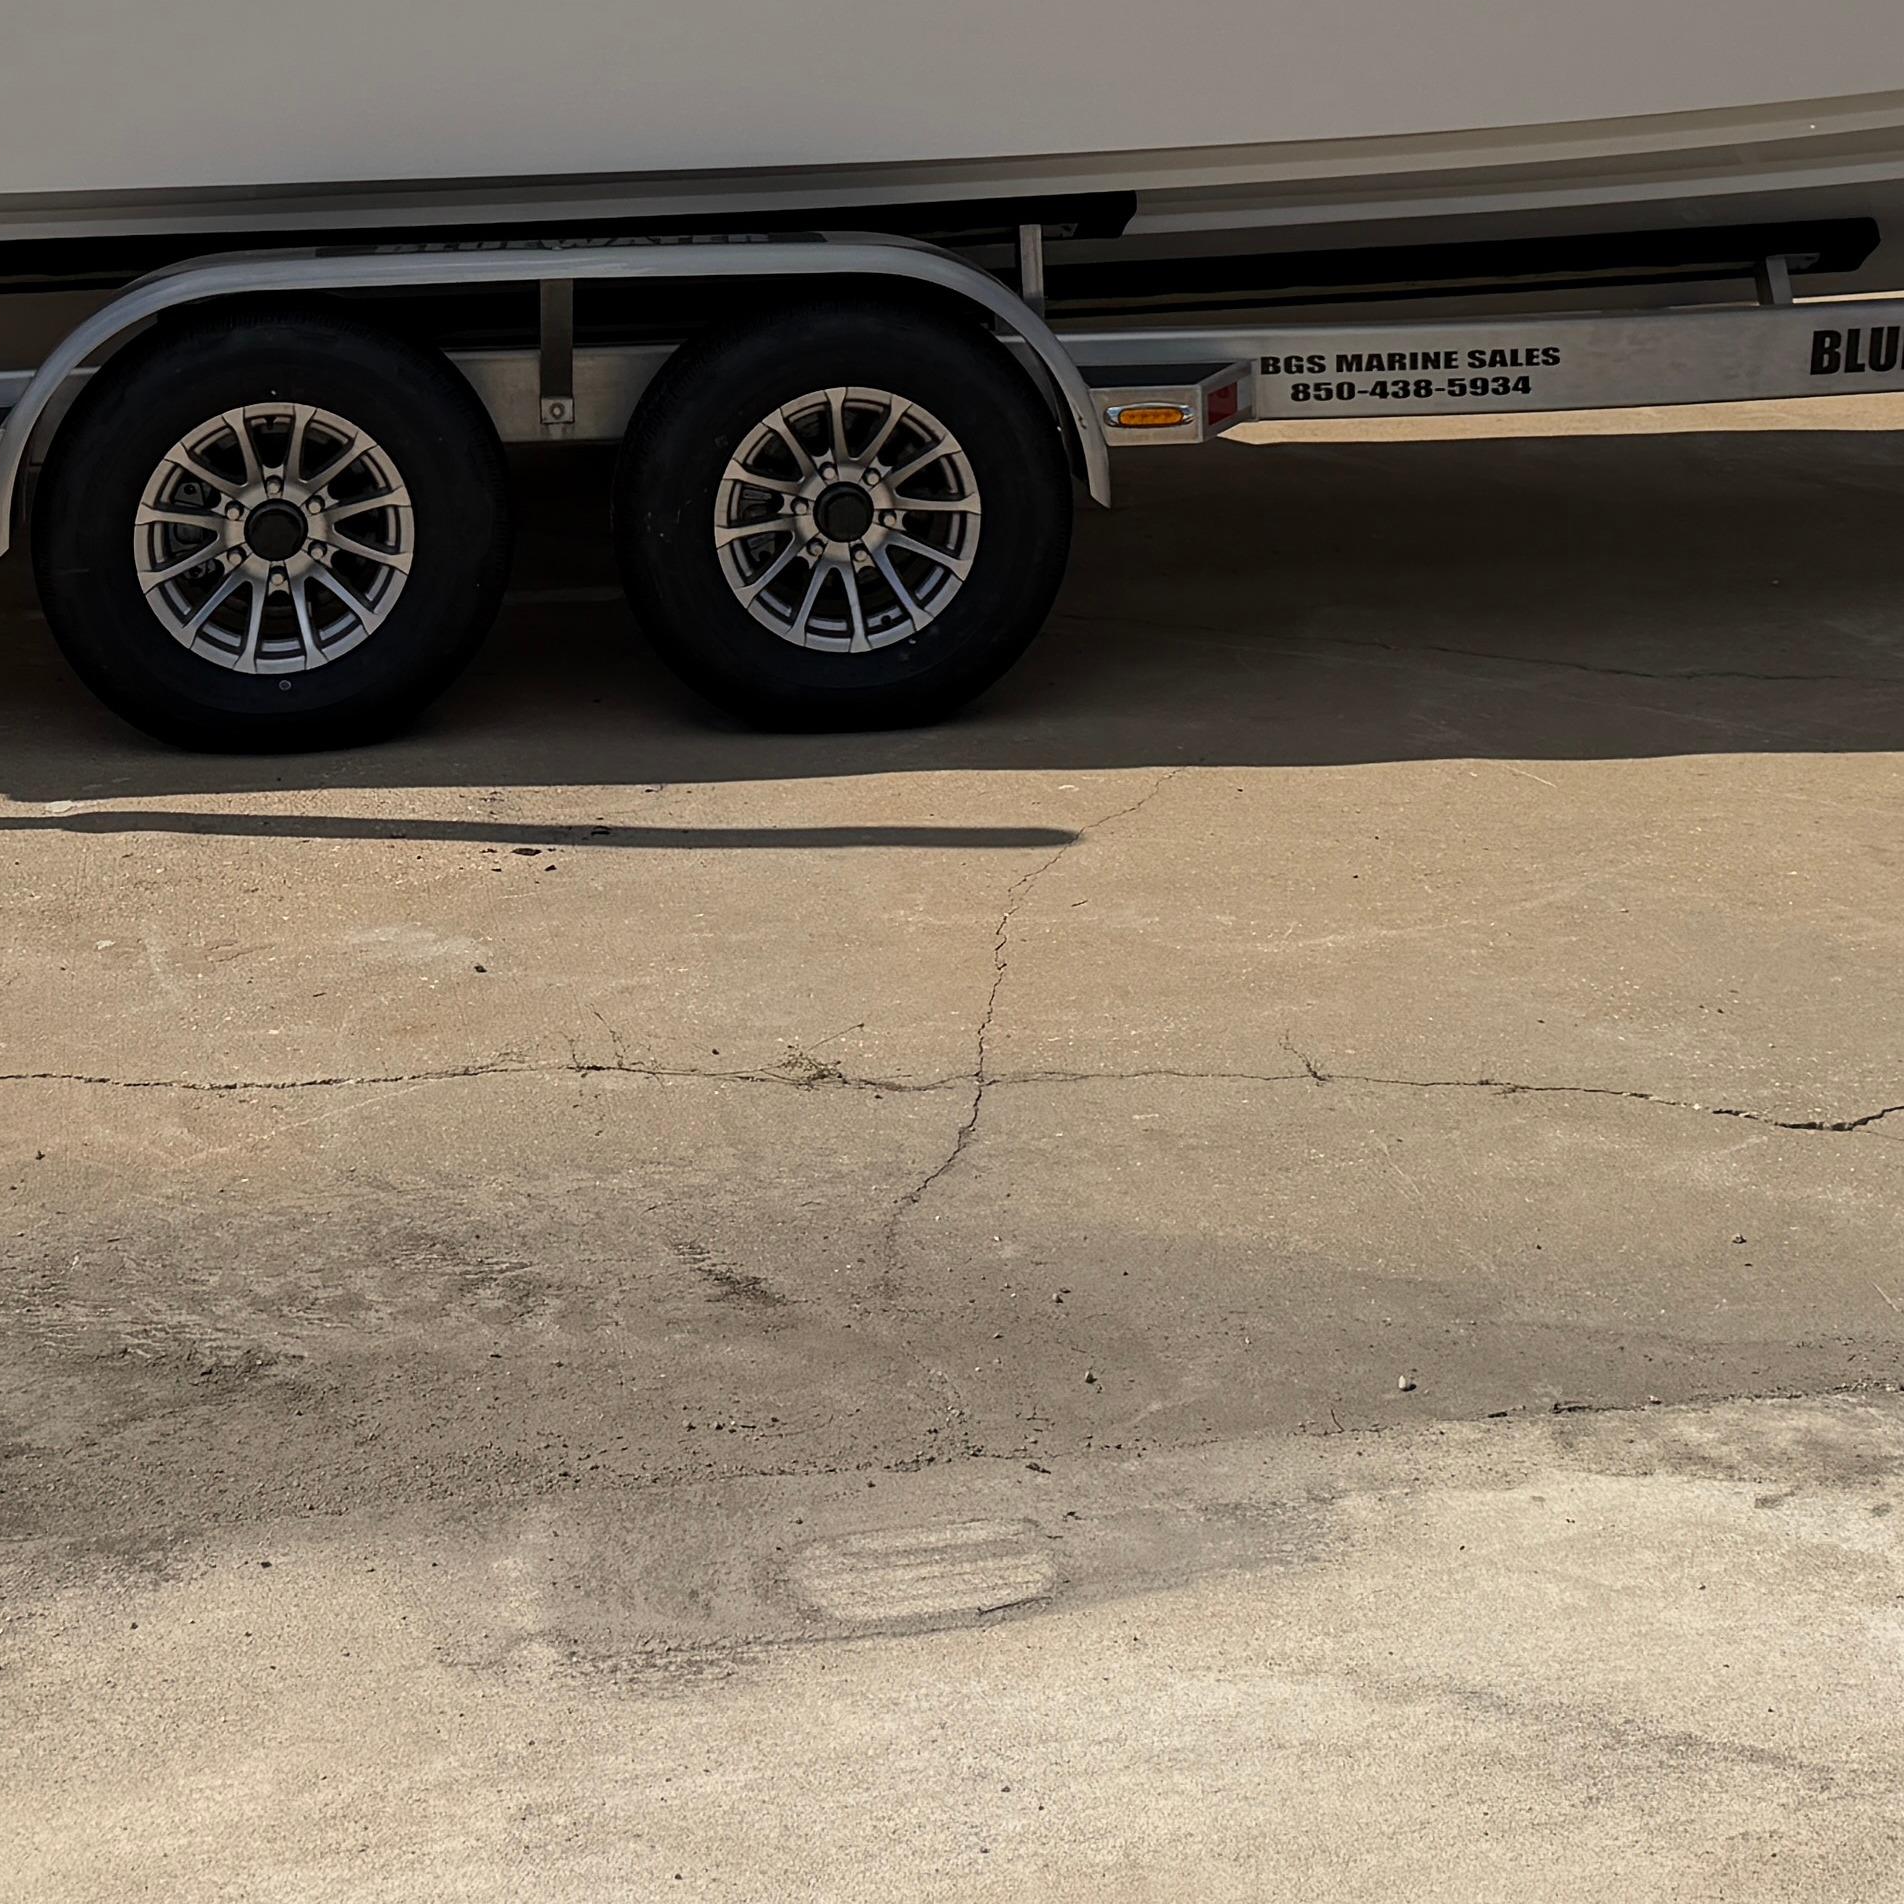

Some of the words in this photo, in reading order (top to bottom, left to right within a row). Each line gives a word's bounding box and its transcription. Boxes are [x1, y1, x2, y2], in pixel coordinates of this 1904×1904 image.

[1260, 355, 1327, 375] BGS
[1335, 350, 1460, 373] MARINE
[1467, 347, 1561, 369] SALES
[1290, 376, 1532, 402] 850-438-5934
